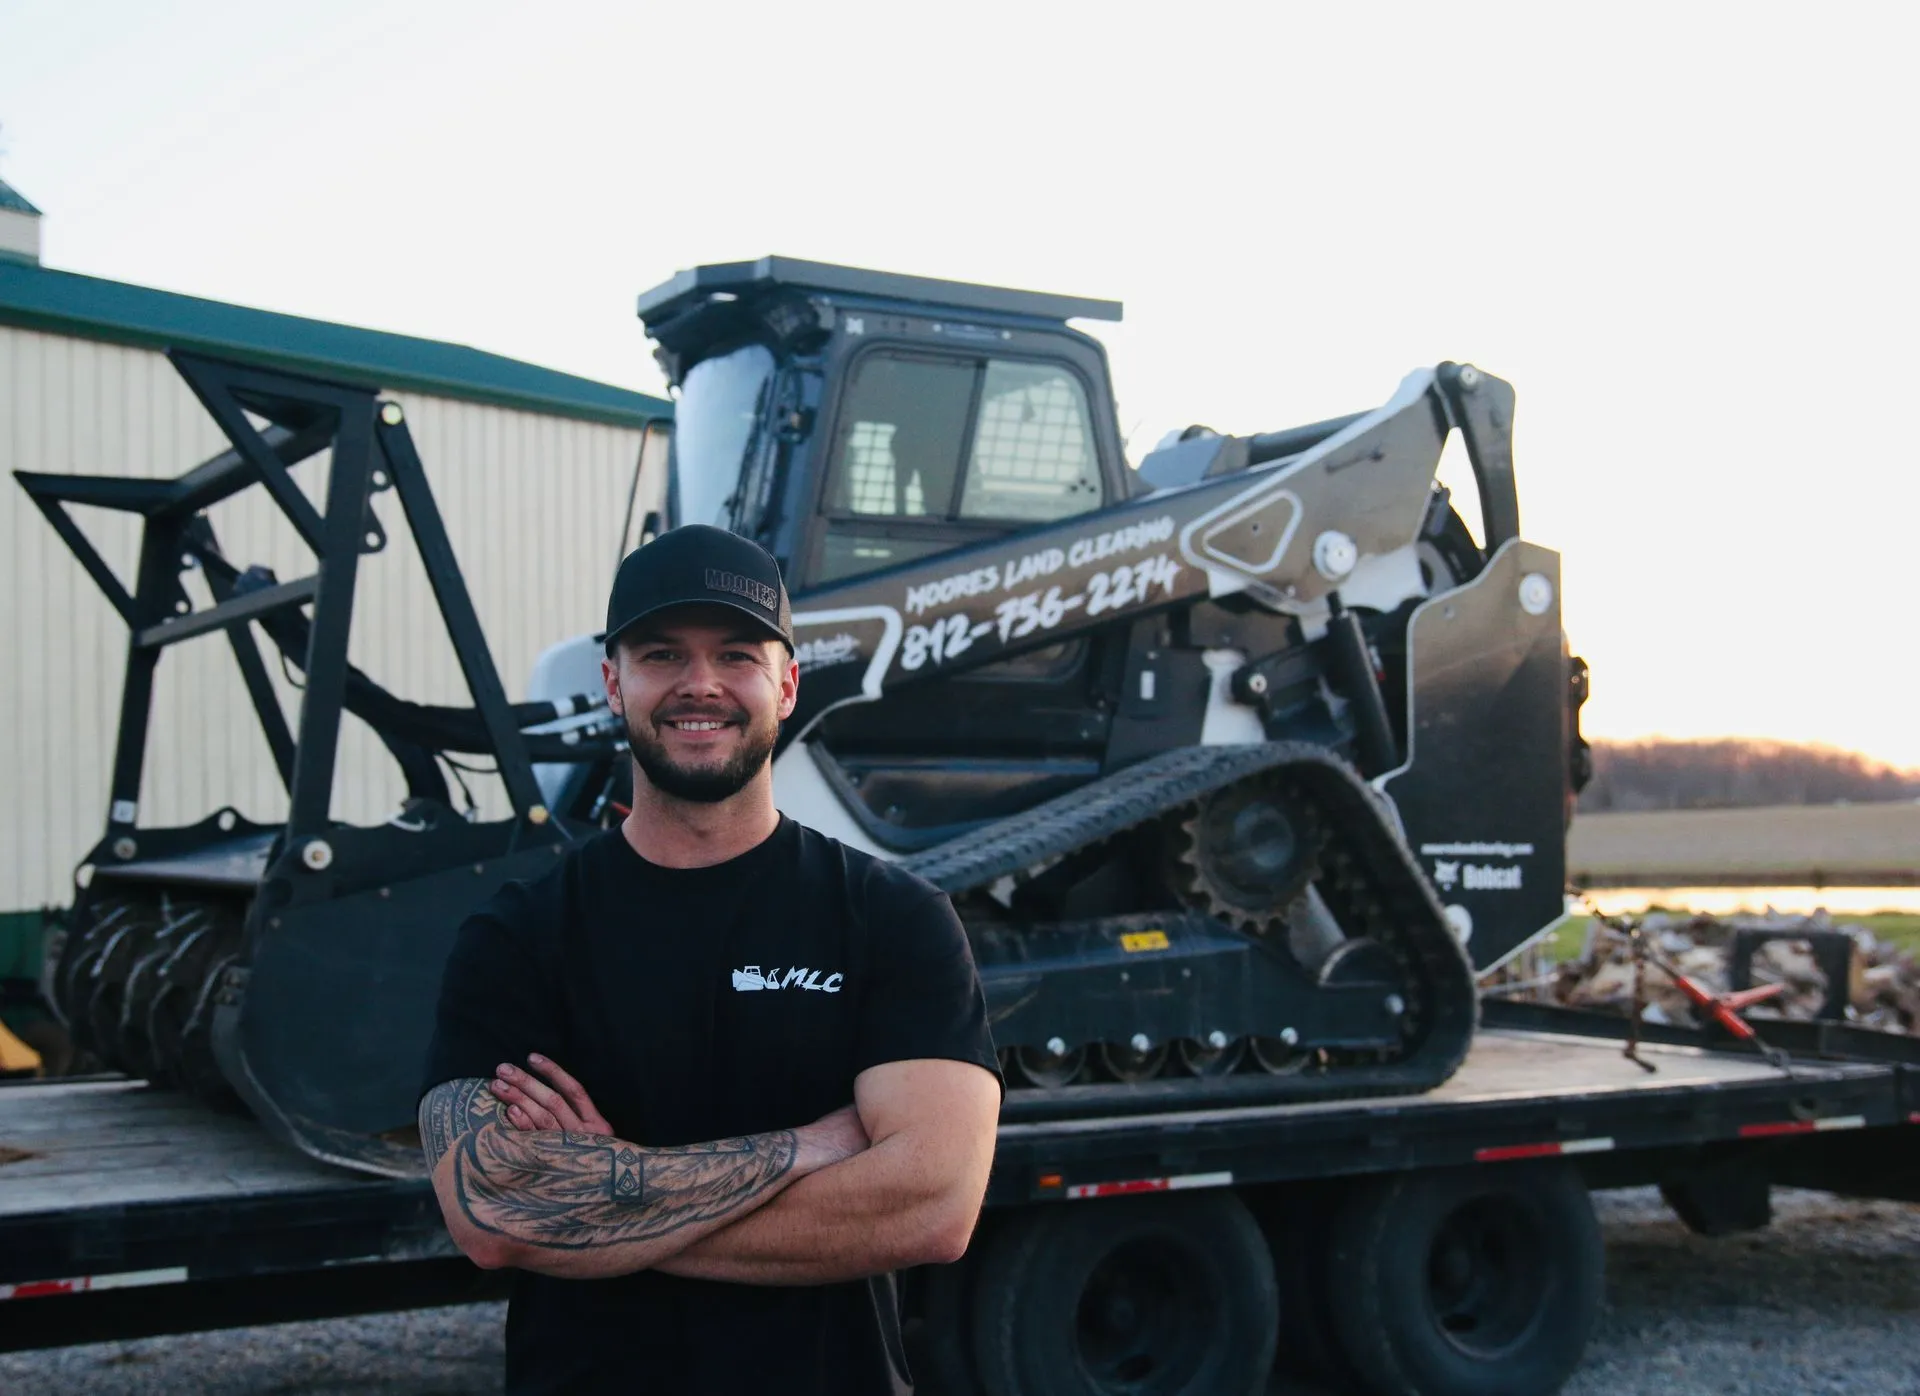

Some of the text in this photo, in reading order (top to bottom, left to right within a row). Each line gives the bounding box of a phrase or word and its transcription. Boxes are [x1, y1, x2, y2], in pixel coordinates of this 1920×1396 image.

[901, 553, 1182, 671] 812-756-2274
[904, 515, 1175, 616] MOORES LAND CLEARING
[780, 965, 844, 993] MLC
